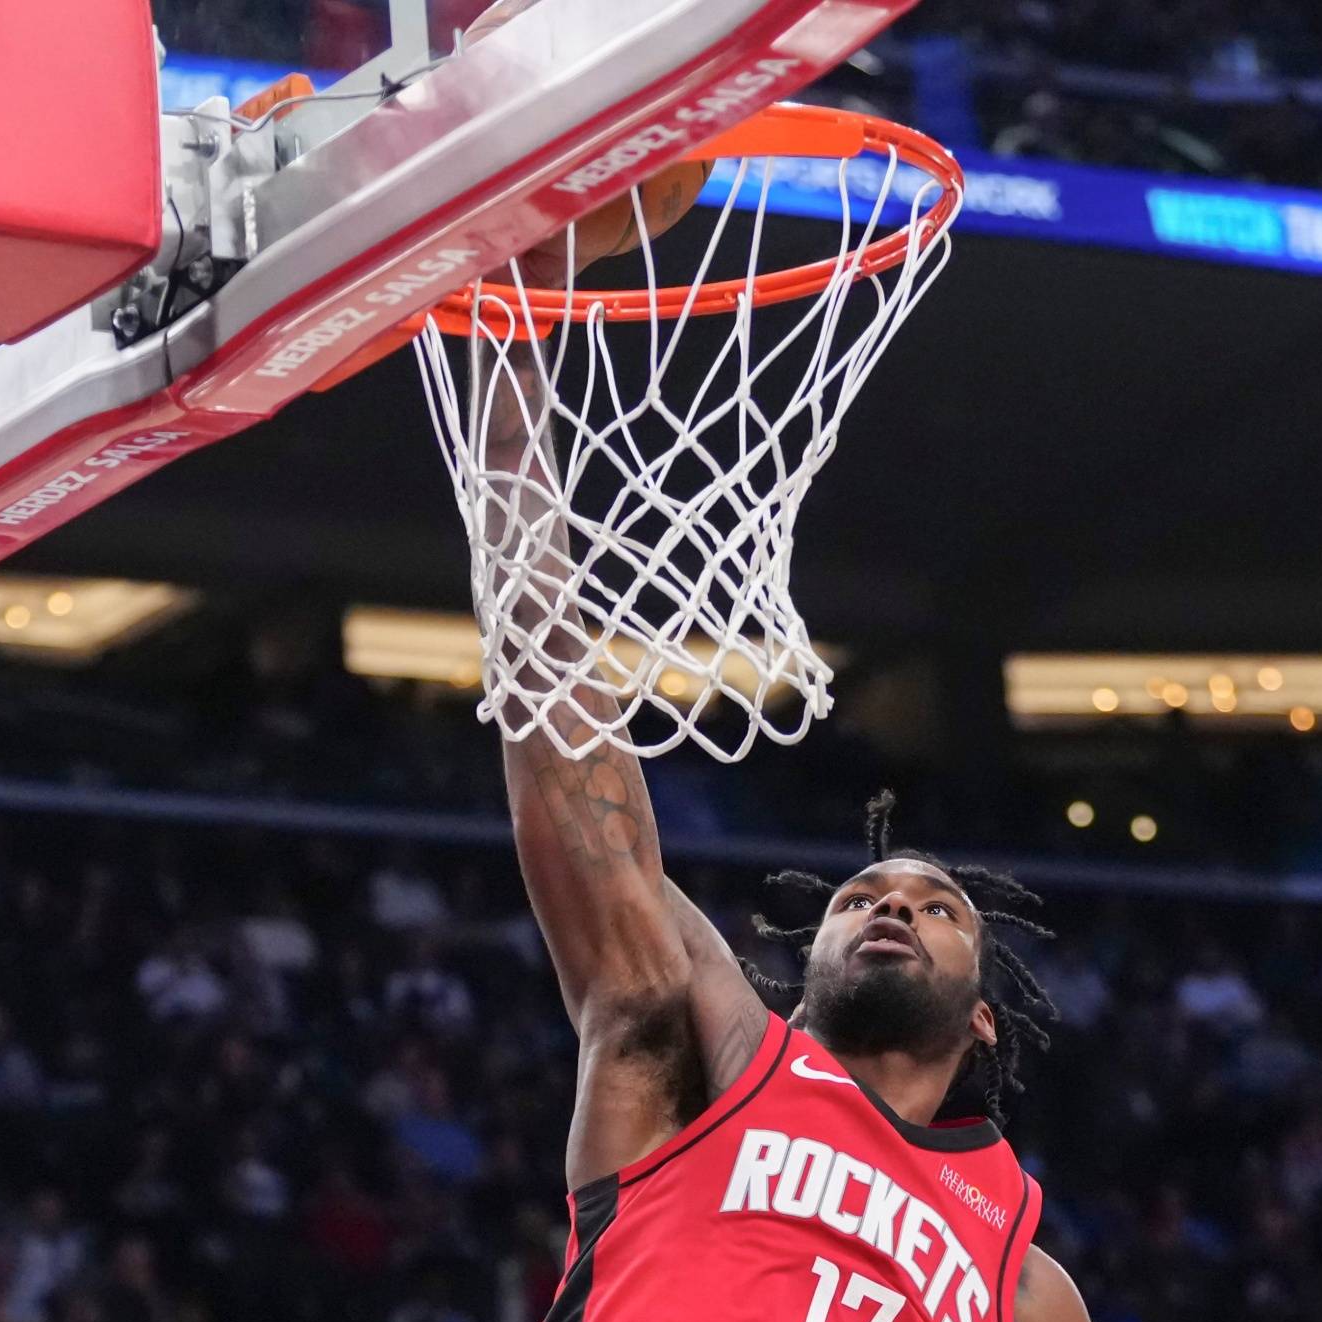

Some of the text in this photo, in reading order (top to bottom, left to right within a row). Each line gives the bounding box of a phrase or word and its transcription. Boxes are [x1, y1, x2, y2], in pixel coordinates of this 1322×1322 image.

[365, 249, 479, 306] SALSA
[85, 430, 186, 469] SALSA
[939, 1174, 1006, 1230] HERMANN
[940, 1163, 1006, 1222] MEMORIAL
